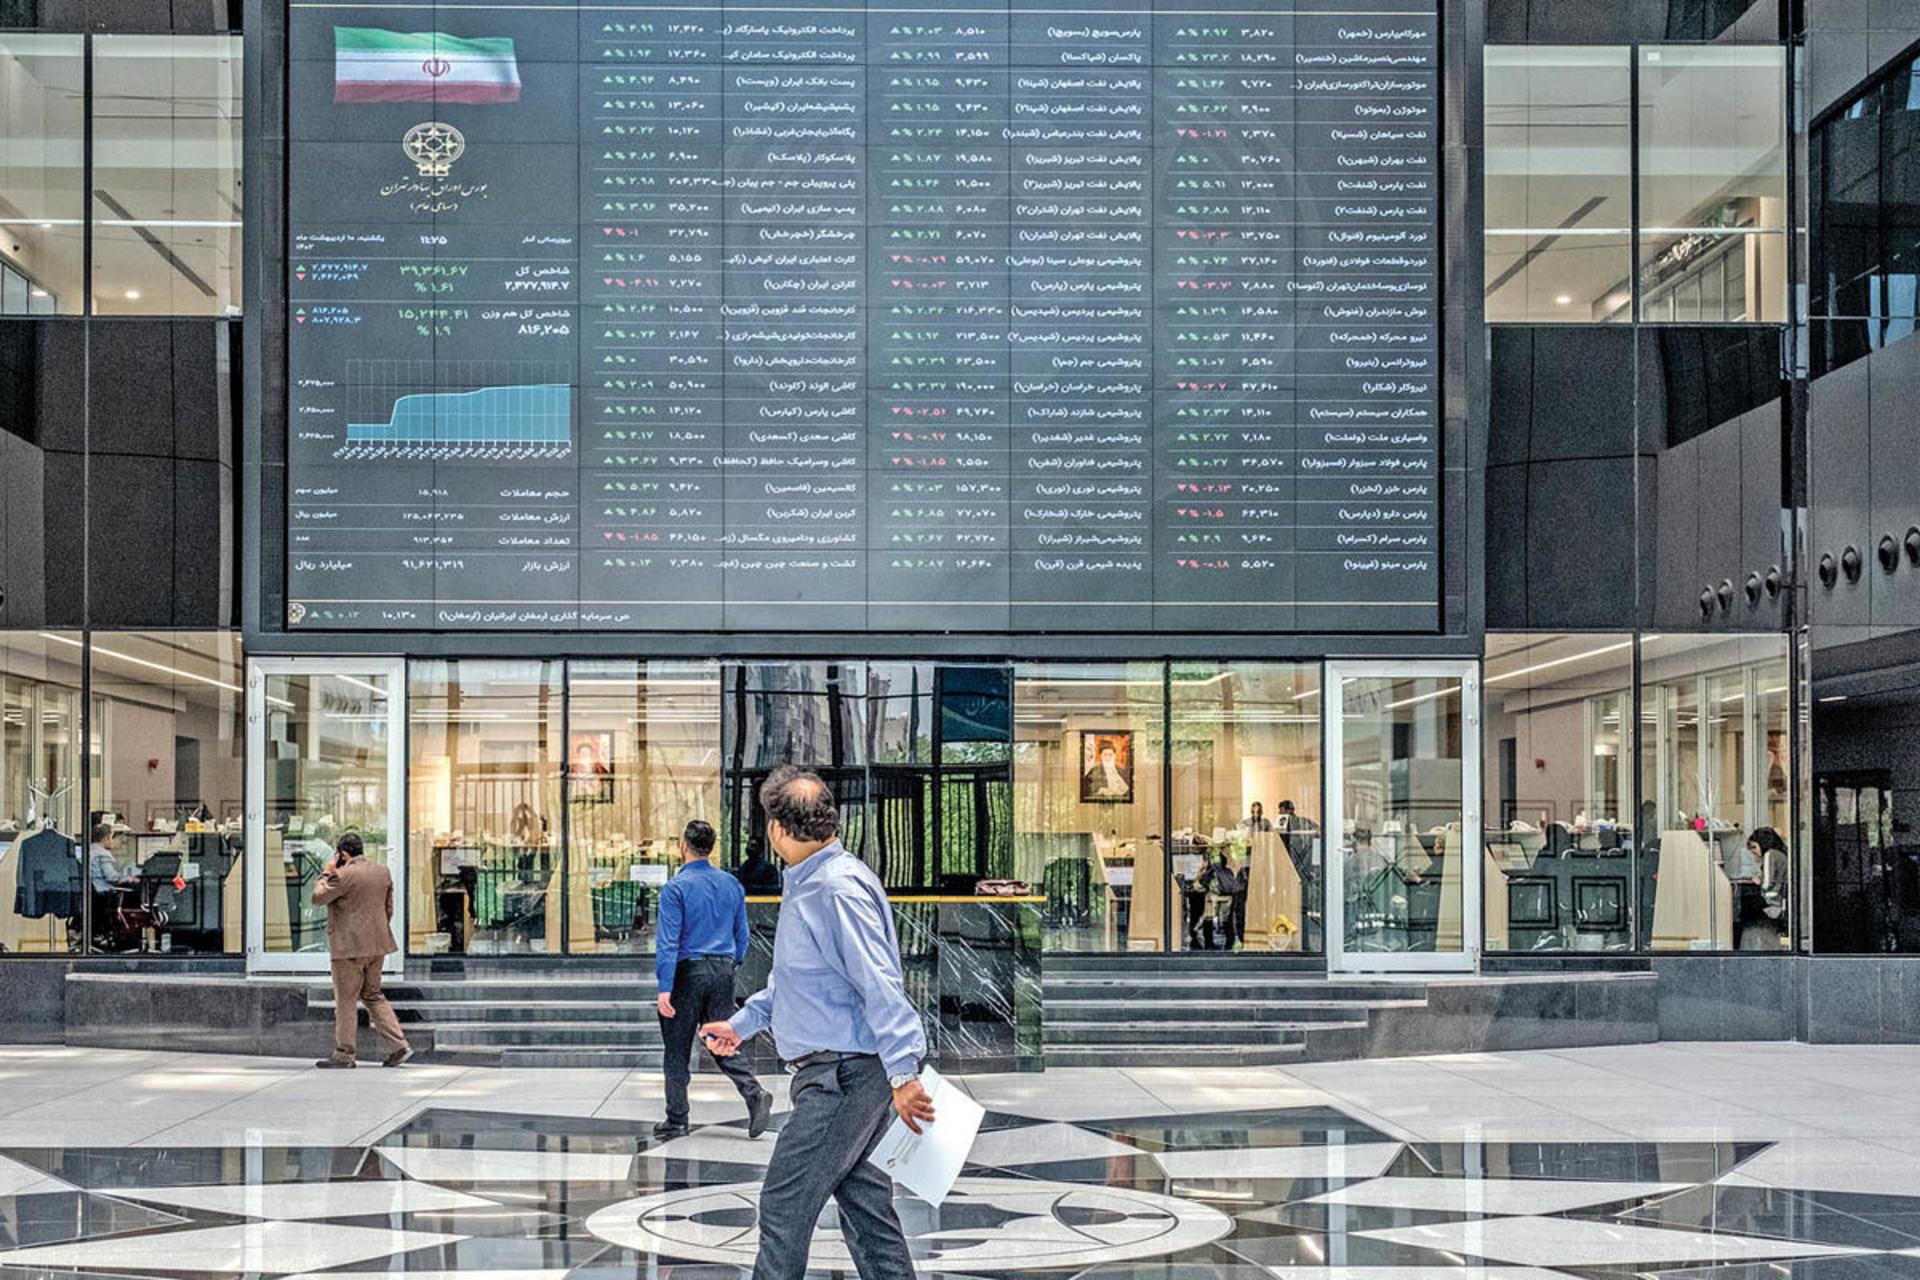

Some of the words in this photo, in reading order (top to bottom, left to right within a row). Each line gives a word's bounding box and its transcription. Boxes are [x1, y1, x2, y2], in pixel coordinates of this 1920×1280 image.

[781, 78, 803, 87] ایران
[806, 77, 827, 86] بانک
[830, 79, 855, 88] پست
[1051, 80, 1084, 89] اصفهان
[1109, 80, 1141, 89] پالایش
[1393, 107, 1427, 115] موتوژن
[1370, 131, 1404, 140] سپاهان
[813, 153, 855, 164] پلاسکوکار
[1064, 156, 1084, 165] تبریز
[1109, 156, 1141, 165] پالایش
[1379, 181, 1404, 191] پارس
[1406, 181, 1427, 189] نفت
[1060, 206, 1084, 215] تهران
[1109, 206, 1141, 216] پالایش
[815, 230, 855, 240] چرخشگر
[1046, 257, 1066, 265] سینا
[1068, 257, 1095, 266] بوعلی
[1097, 257, 1141, 266] پتروشیمی
[515, 266, 529, 277] کل
[533, 267, 570, 277] شاخص
[807, 281, 829, 290] ایران
[832, 281, 855, 290] کارتن
[1070, 282, 1094, 291] پارس
[1097, 282, 1142, 291] پتروشیمی
[762, 305, 789, 315] قزوین
[792, 305, 806, 313] قند
[809, 307, 855, 315] کارخانجات
[482, 311, 500, 319] وزن
[503, 311, 517, 319] هم
[520, 310, 533, 319] کل
[536, 310, 570, 319] شاخص
[1097, 358, 1142, 368] پتروشیمی
[809, 382, 829, 392] الوند
[832, 382, 856, 392] کاشی
[1061, 383, 1094, 393] خراسان
[1097, 384, 1142, 393] پتروشیمی
[1356, 410, 1389, 418] سیستم
[1391, 408, 1428, 418] همکاران
[832, 433, 856, 442] کاشی
[1074, 434, 1094, 443] غدیر
[1097, 434, 1141, 443] پتروشیمی
[1368, 433, 1389, 441] ملت
[1391, 434, 1428, 444] واسپاری
[787, 457, 829, 468] وسرامیک
[832, 458, 855, 467] کاشی
[813, 484, 856, 493] کالسیمین
[1072, 486, 1095, 495] نوری
[1097, 485, 1142, 495] پتروشیمی
[1384, 485, 1400, 494] خزر
[1402, 485, 1427, 495] پارس
[545, 491, 569, 499] حجم
[544, 513, 570, 523] ارزش
[811, 509, 832, 519] ایران
[835, 509, 855, 519] کربن
[1383, 510, 1400, 519] دارو
[1402, 510, 1427, 520] پارس
[295, 560, 316, 570] ریال
[319, 560, 352, 570] میلیارد
[523, 562, 541, 571] بازار
[544, 562, 570, 571] ارزش
[1066, 560, 1084, 570] قرن
[1086, 561, 1113, 570] شیمی
[1116, 562, 1142, 570] پدیده
[383, 611, 416, 620] ۱۰,۱۳۰
